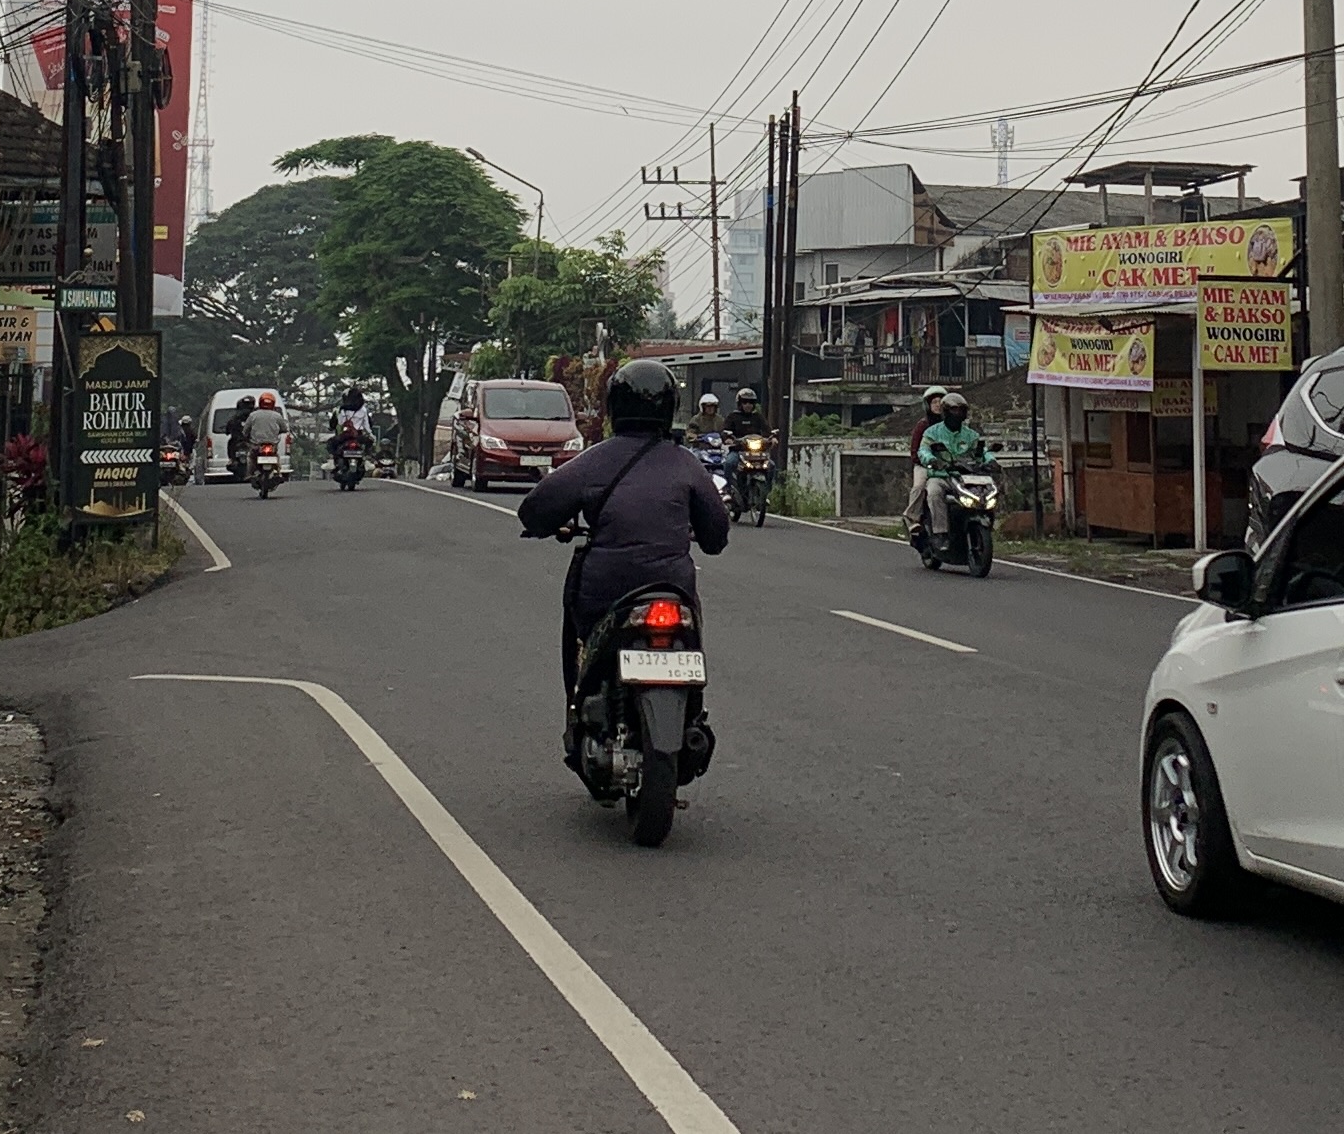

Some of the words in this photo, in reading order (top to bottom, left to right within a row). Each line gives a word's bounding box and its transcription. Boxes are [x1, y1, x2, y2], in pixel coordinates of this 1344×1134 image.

[1065, 234, 1097, 252] MIE
[1100, 231, 1149, 251] AYAM
[1156, 229, 1167, 247] &
[1173, 226, 1245, 246] BAKSO
[1118, 251, 1183, 265] WONOGIRI
[28, 261, 51, 272] SITI
[1102, 269, 1147, 287] CAK
[1203, 288, 1235, 303] MIE
[1239, 289, 1286, 305] AYAM
[21, 317, 29, 327] &
[1204, 306, 1219, 322] &
[1223, 307, 1285, 324] BAKSO
[1206, 327, 1285, 342] WONOGIRI
[1070, 337, 1114, 351] WONOGIRI
[1068, 353, 1091, 371] CAK
[1214, 345, 1245, 362] CAK
[1249, 346, 1279, 363] MET
[86, 380, 122, 389] MASJID
[89, 393, 145, 411] BAITUR
[83, 411, 152, 430] ROHMAN
[94, 467, 139, 480] HAQIQI
[623, 653, 631, 664] N
[637, 653, 668, 665] 3173
[677, 653, 702, 665] EFR
